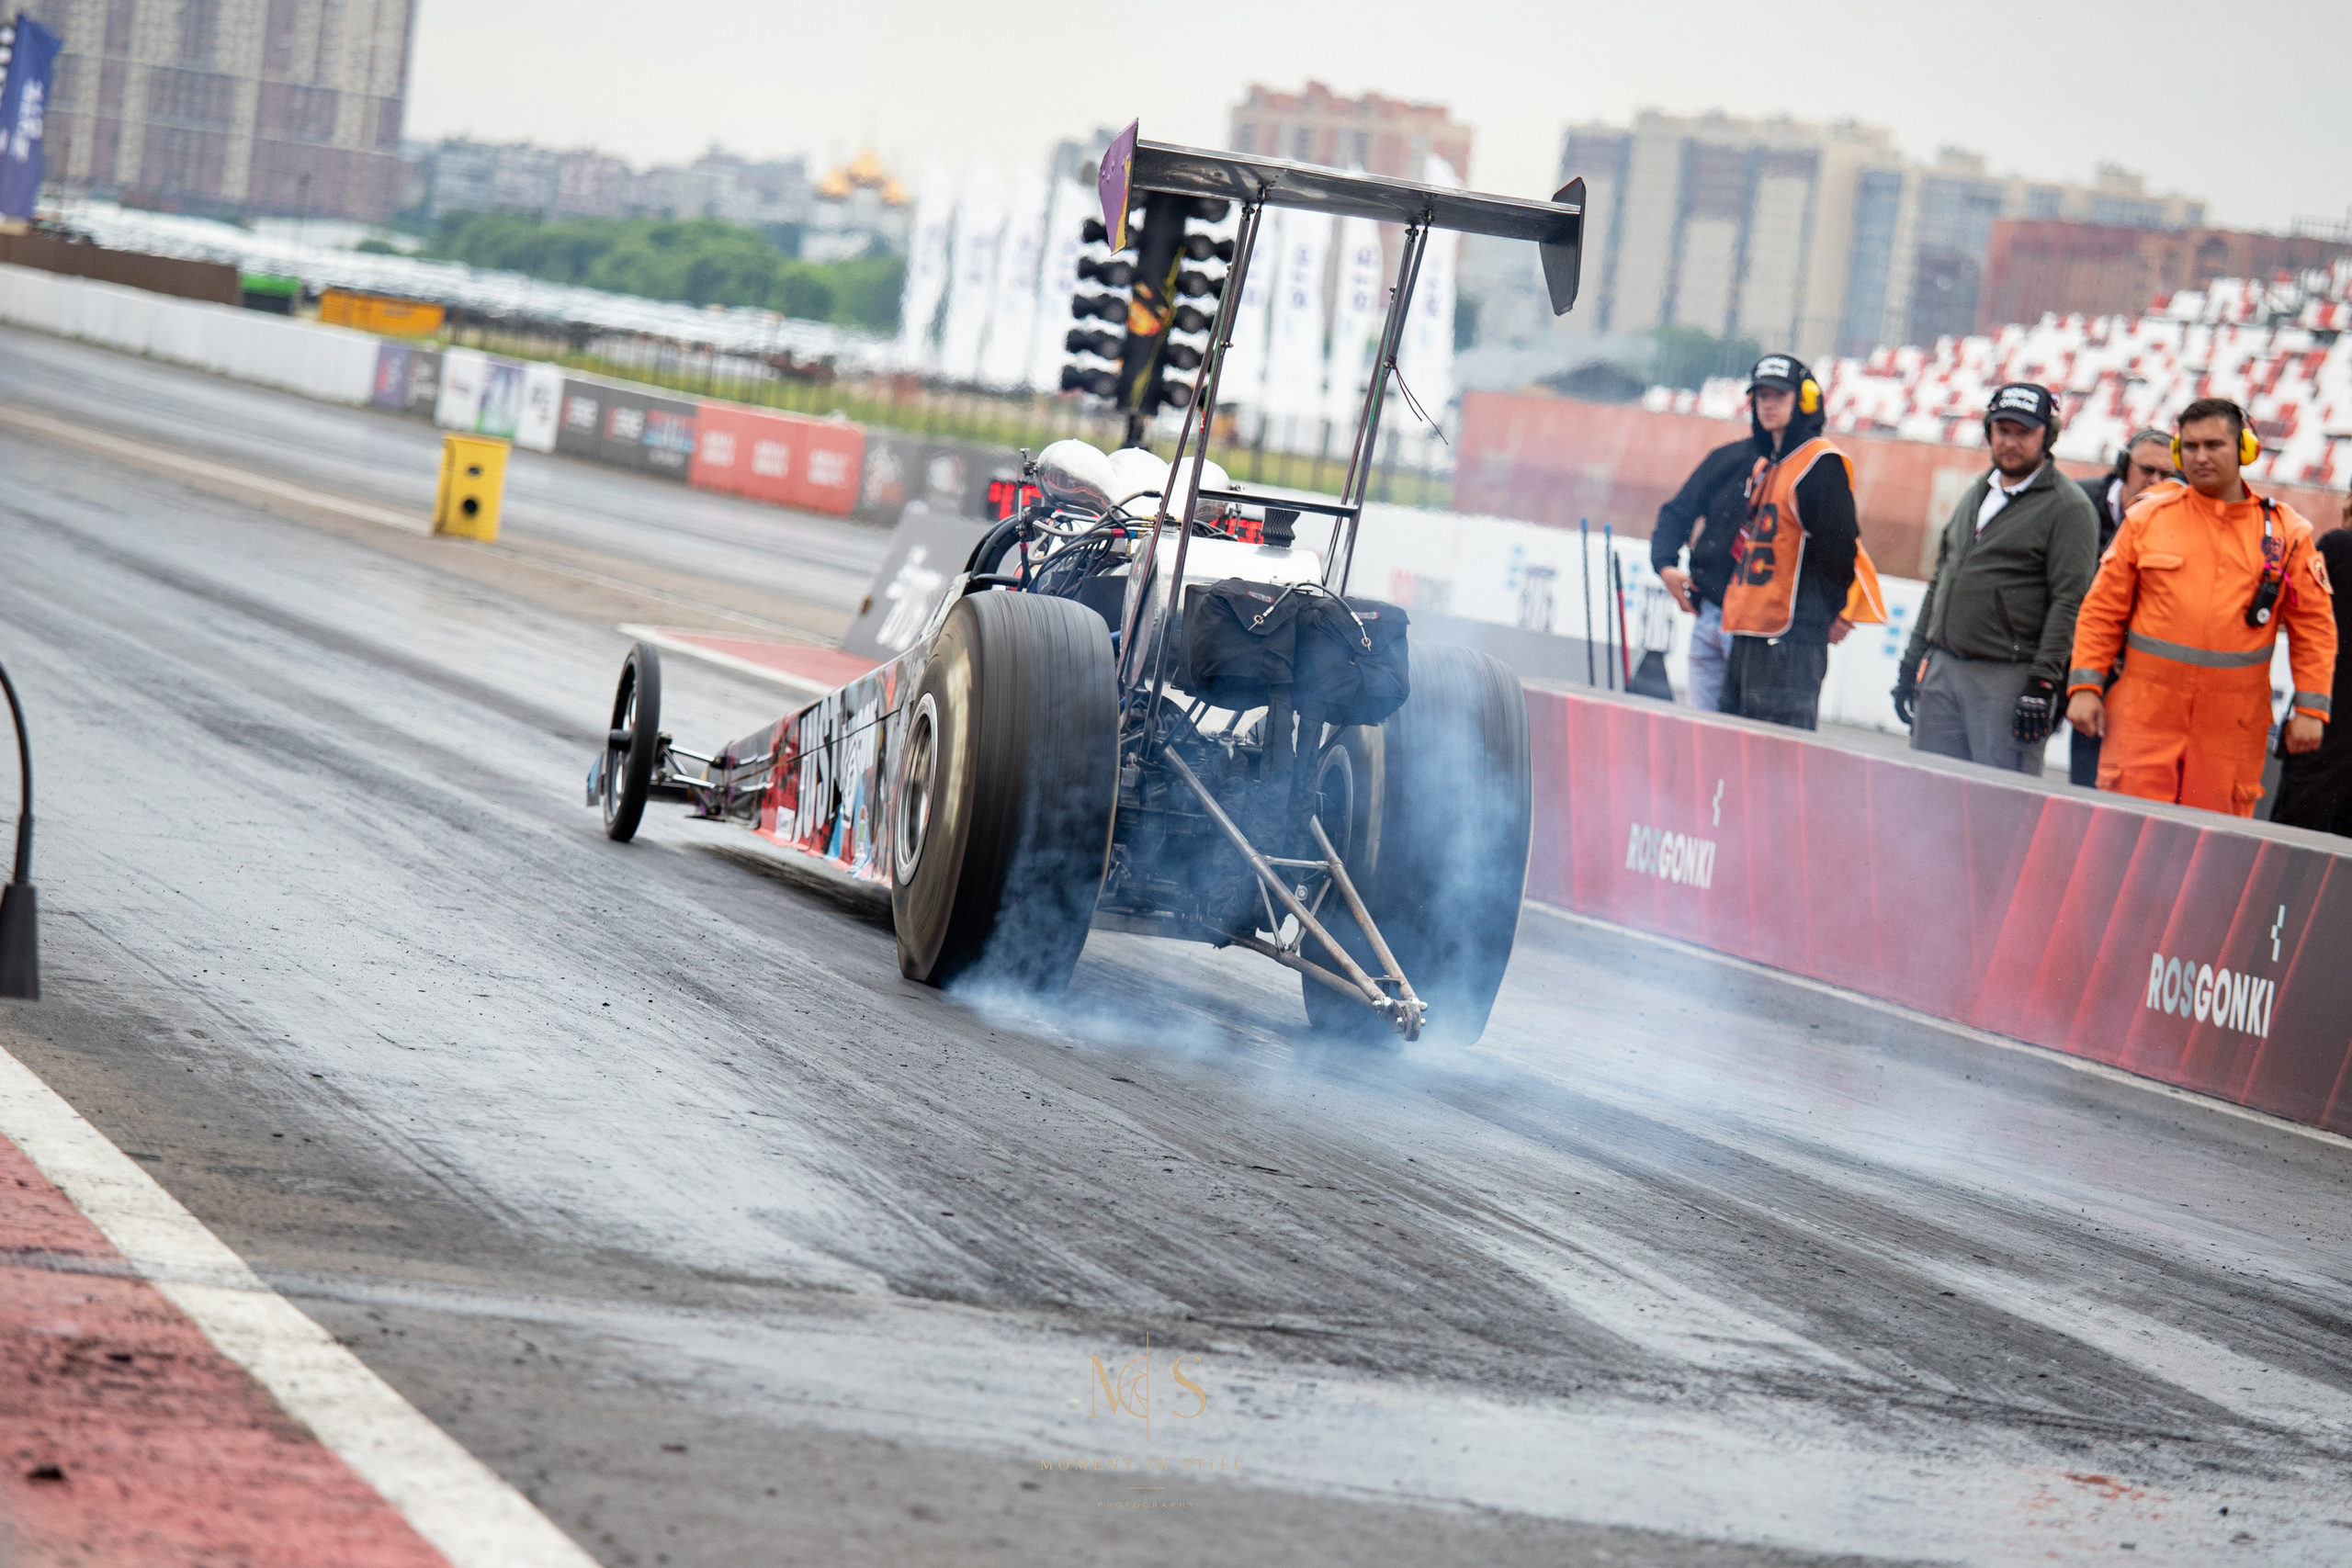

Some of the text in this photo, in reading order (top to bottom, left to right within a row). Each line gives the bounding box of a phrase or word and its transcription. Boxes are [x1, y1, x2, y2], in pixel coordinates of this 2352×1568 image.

[793, 689, 842, 844] JUST
[1625, 822, 1716, 889] ROSGONKI
[2145, 952, 2276, 1040] ROSGONKI
